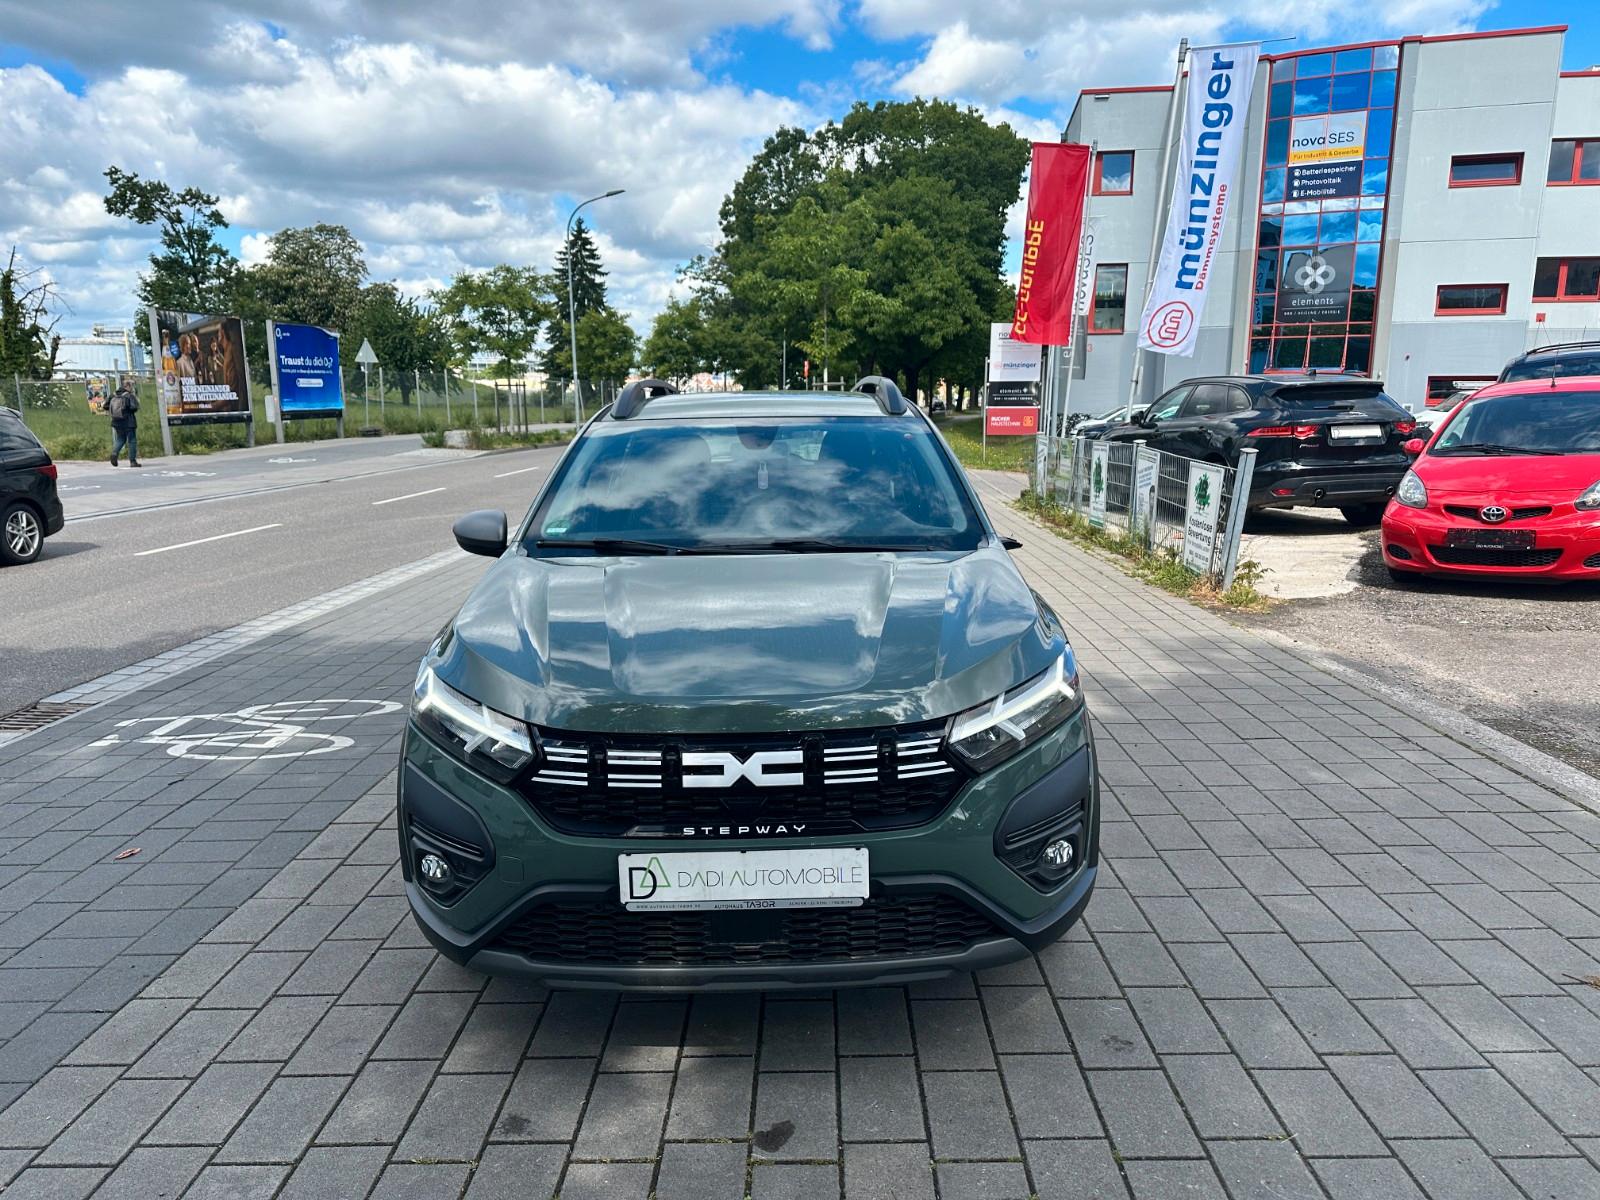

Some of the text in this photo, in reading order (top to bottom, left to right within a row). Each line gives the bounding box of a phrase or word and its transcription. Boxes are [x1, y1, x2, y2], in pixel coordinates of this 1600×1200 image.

[1175, 52, 1235, 291] münzinger
[1301, 166, 1357, 176] Batteriespeicher
[1300, 177, 1342, 186] Photovoltaik
[1300, 188, 1336, 197] E-Mobilität
[1194, 183, 1228, 290] Dämmsysteme
[1291, 297, 1334, 306] elements
[280, 354, 304, 366] Traust
[305, 356, 312, 366] du
[312, 356, 324, 366] dich
[1003, 361, 1037, 369] münzinger
[180, 376, 196, 385] VOM
[181, 384, 231, 394] NEBENEINANDER
[183, 392, 197, 401] ZUM
[1188, 526, 1211, 547] Bewertung
[683, 824, 807, 836] STEPWAY
[677, 866, 864, 888] DADI AUTOMOBILE
[744, 901, 776, 909] TABOR
